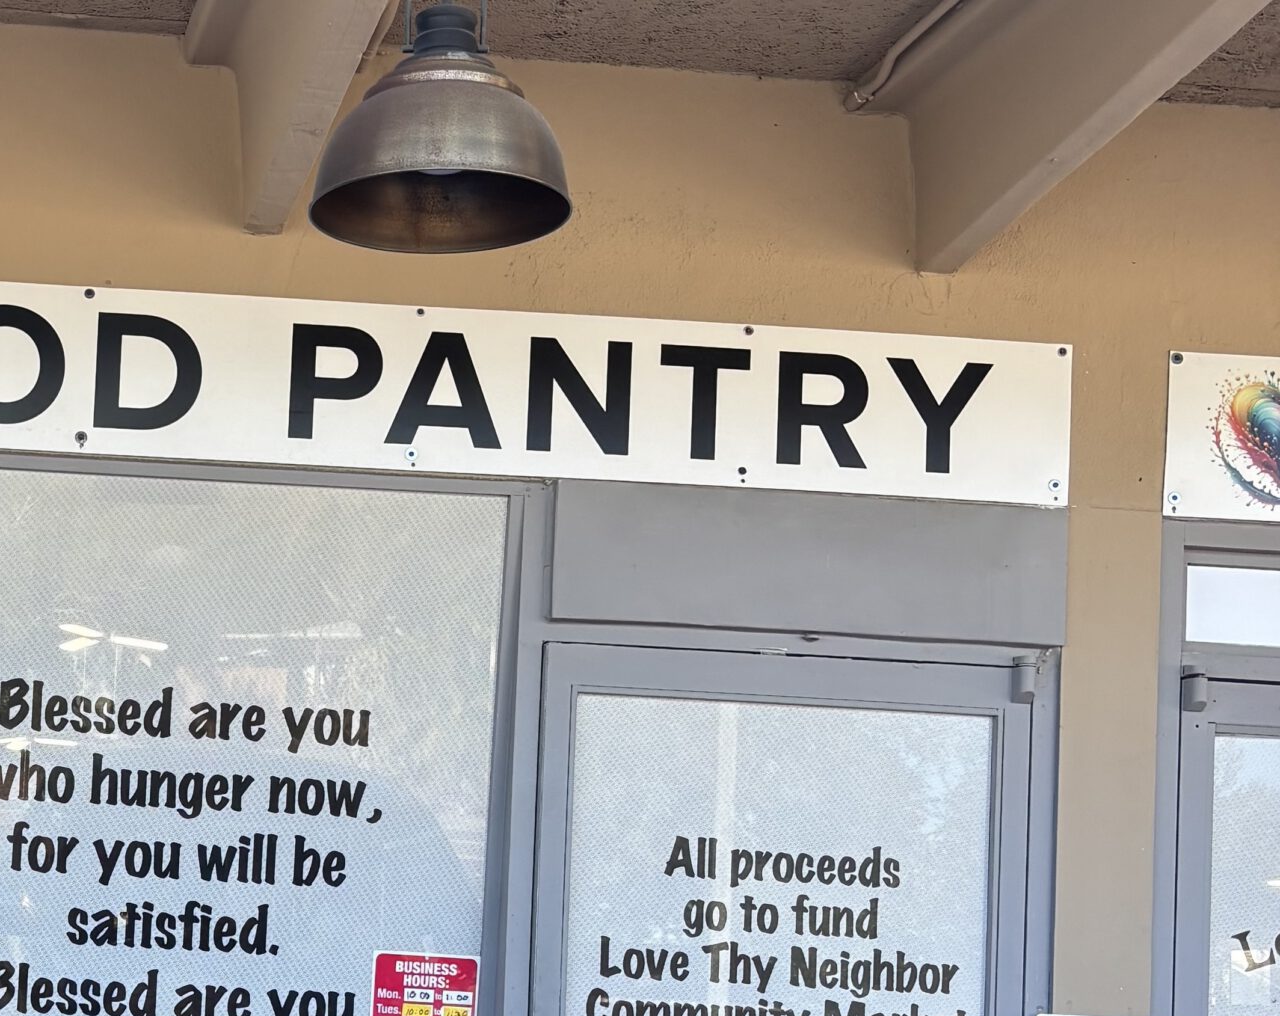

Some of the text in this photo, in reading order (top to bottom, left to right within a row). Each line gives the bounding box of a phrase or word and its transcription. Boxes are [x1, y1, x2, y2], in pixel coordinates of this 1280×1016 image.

[288, 323, 994, 474] PANTRY
[0, 678, 370, 753] Blessed are you
[90, 753, 254, 819] hunger
[268, 776, 382, 823] now,
[7, 822, 346, 887] for you will be
[665, 836, 899, 888] All proceeds
[67, 901, 279, 955] satisfied.
[683, 895, 878, 939] go to fund
[378, 988, 401, 999] Mon.
[395, 960, 458, 976] BUSINESS
[403, 974, 450, 988] HOURS:
[600, 936, 959, 998] Love Thy Neighbor
[376, 1004, 401, 1014] Tues.
